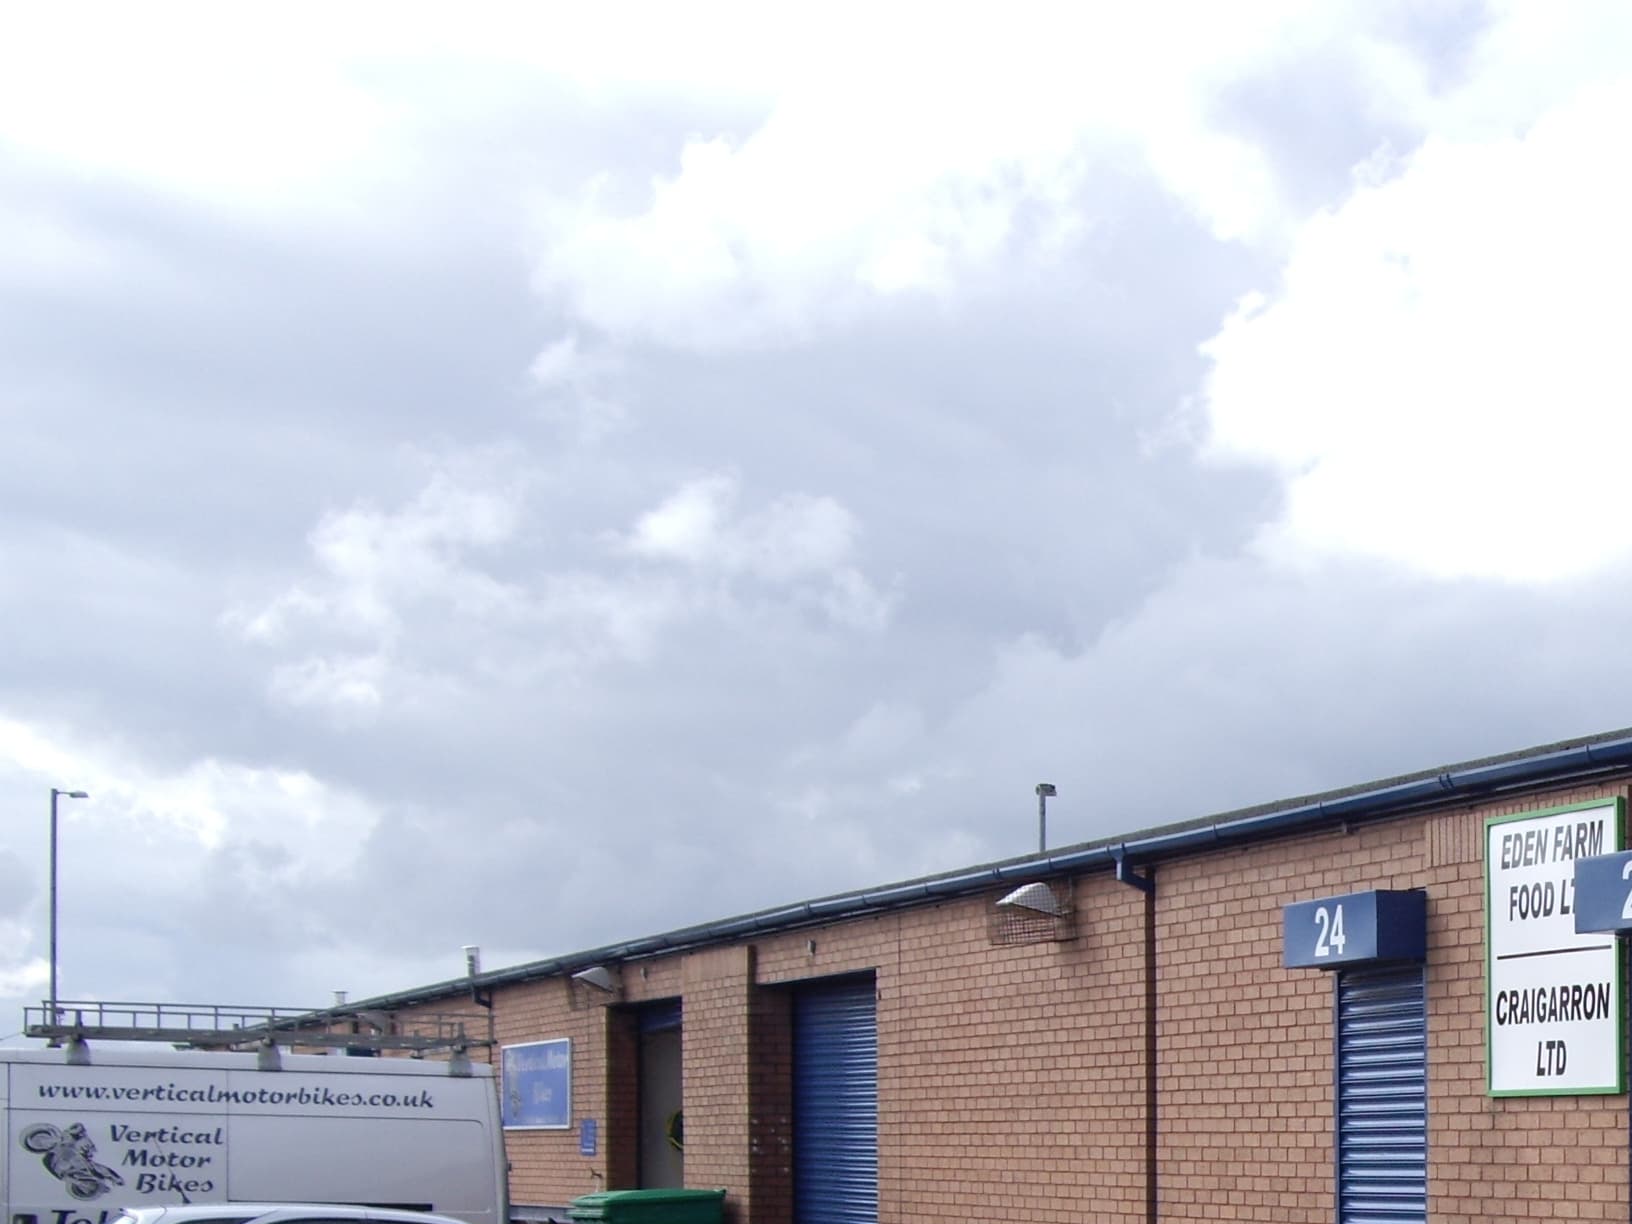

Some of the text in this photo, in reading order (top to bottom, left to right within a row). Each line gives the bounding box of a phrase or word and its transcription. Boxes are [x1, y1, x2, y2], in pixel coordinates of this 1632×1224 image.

[1501, 820, 1604, 870] EDEN FARM
[1510, 881, 1554, 921] FOOD
[1314, 904, 1346, 957] 24
[1496, 982, 1611, 1026] CRAIGARRON
[1536, 1039, 1567, 1076] LTD
[38, 1083, 434, 1109] www.verticalmotorbikes.co.uk
[109, 1124, 224, 1145] Vertical
[121, 1149, 212, 1168] Motor
[135, 1173, 215, 1194] Bikes
